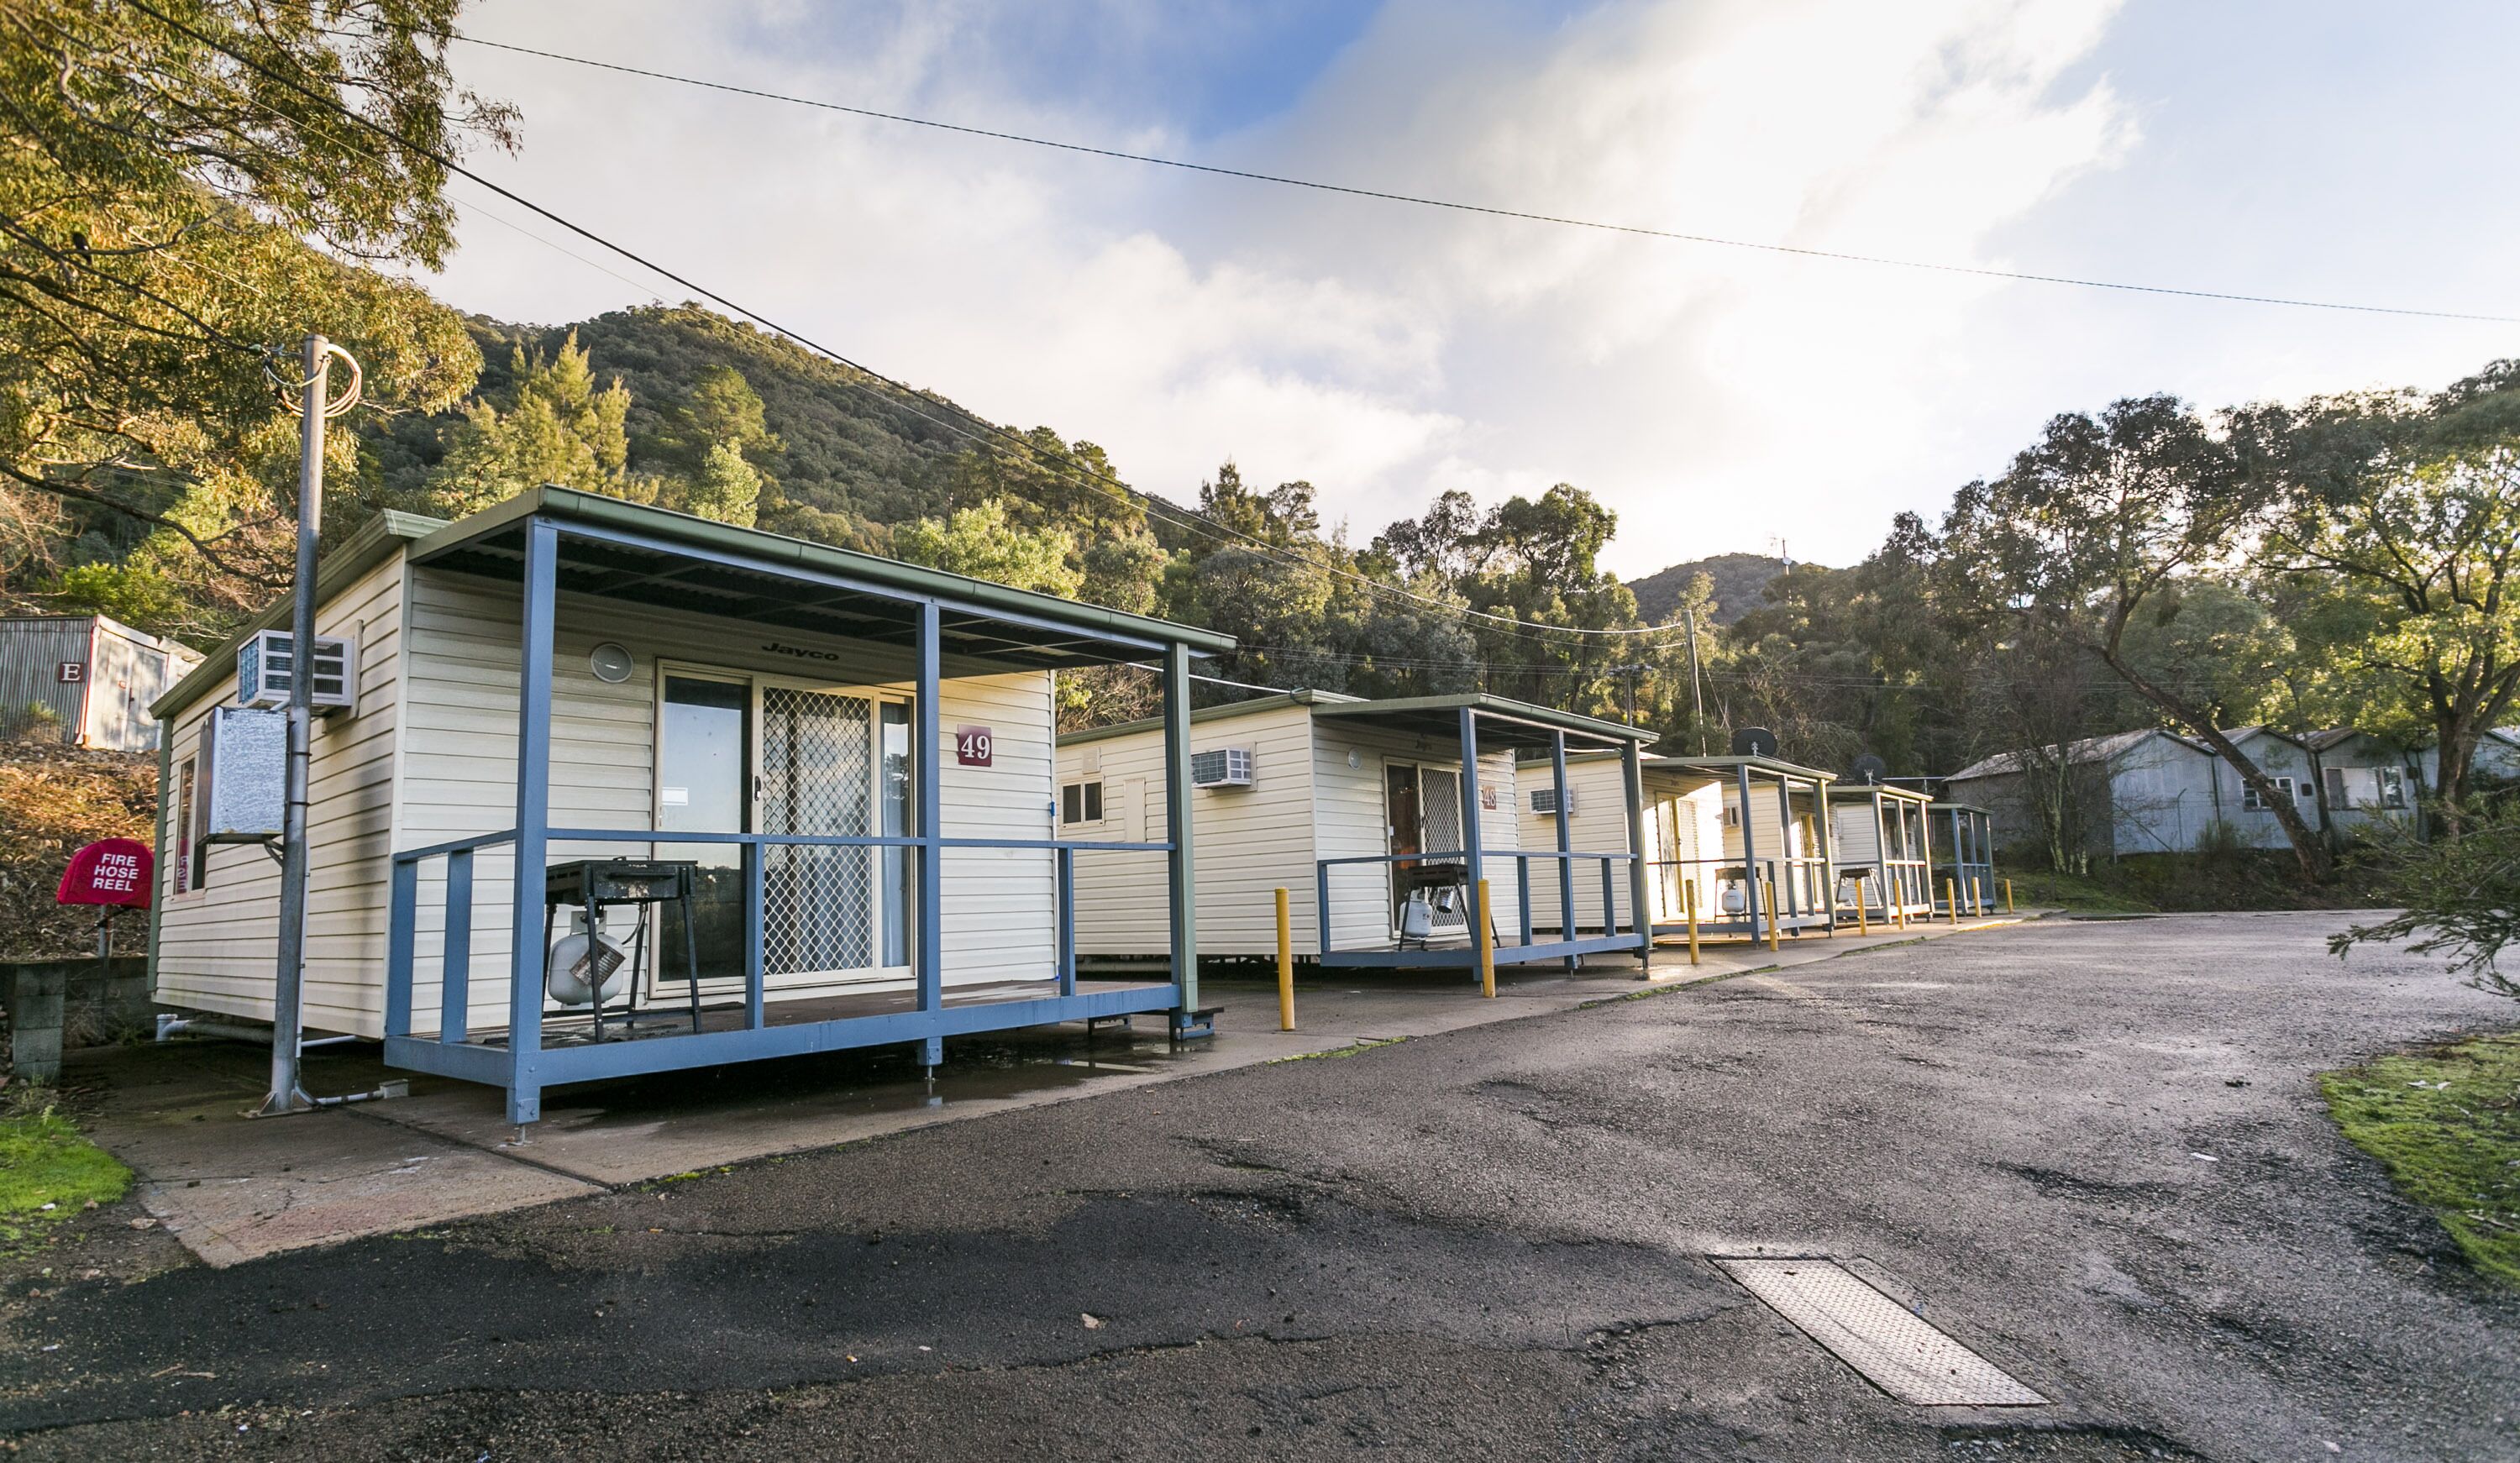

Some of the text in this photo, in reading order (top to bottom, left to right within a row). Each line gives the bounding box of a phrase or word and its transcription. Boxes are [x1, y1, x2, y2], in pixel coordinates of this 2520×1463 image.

[761, 642, 839, 661] Jayco
[60, 663, 81, 681] E
[961, 734, 990, 759] 49
[1484, 789, 1495, 806] 48
[102, 853, 138, 867] FIRE
[93, 865, 139, 879] HOSE
[92, 878, 134, 892] REEL
